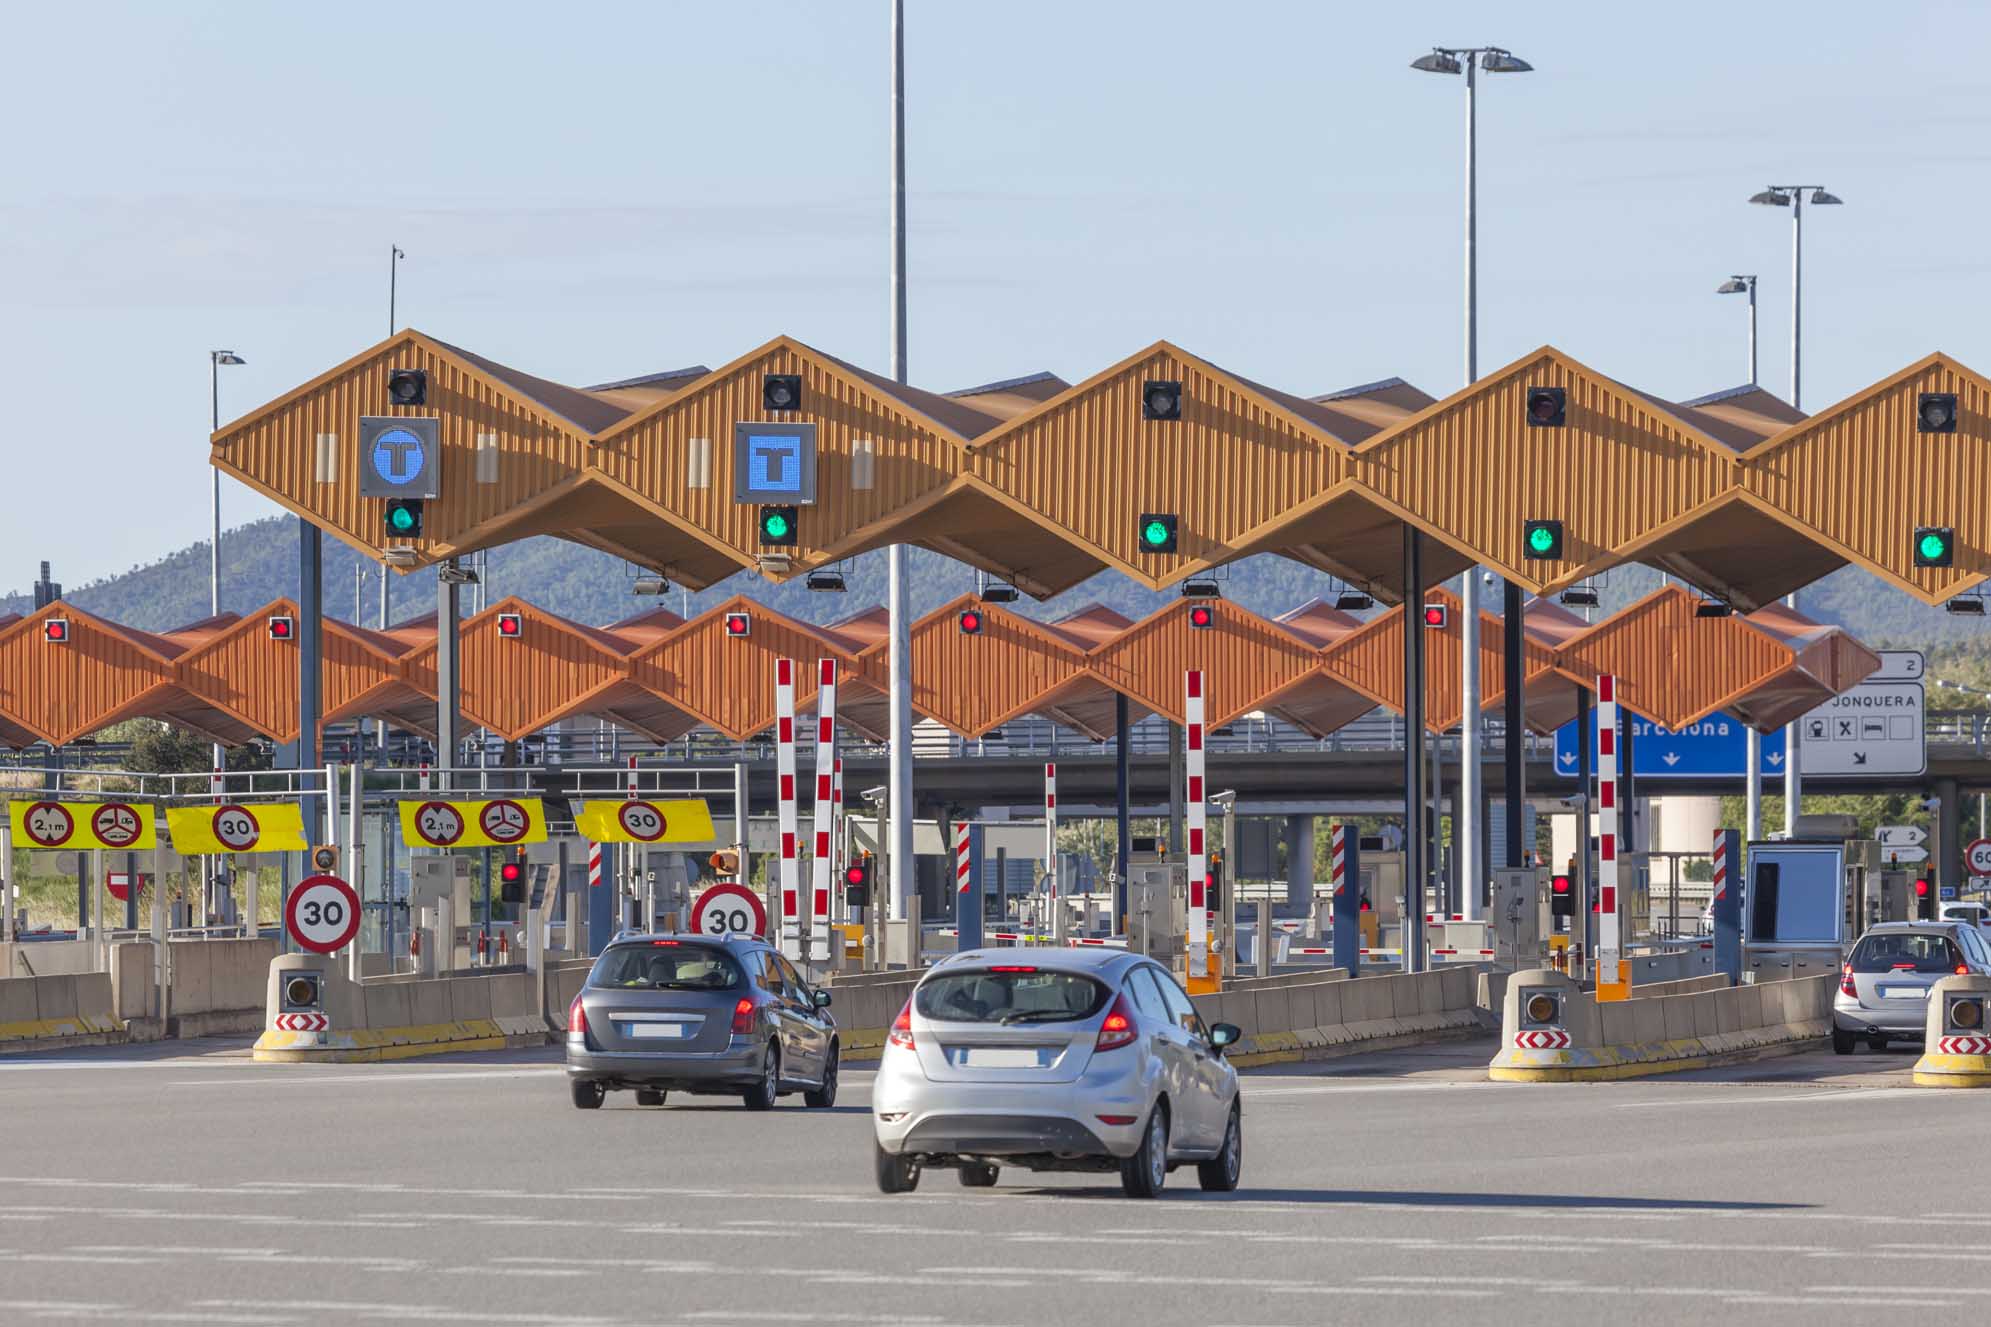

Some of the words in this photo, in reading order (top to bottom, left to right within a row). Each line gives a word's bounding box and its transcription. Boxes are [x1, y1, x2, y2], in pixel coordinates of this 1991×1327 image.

[1906, 660, 1916, 671] 2
[1831, 695, 1916, 707] JONQUERA
[222, 820, 250, 835] 30
[628, 814, 657, 828] 30
[1908, 831, 1917, 841] 2
[303, 901, 344, 927] 30
[709, 909, 748, 934] 30
